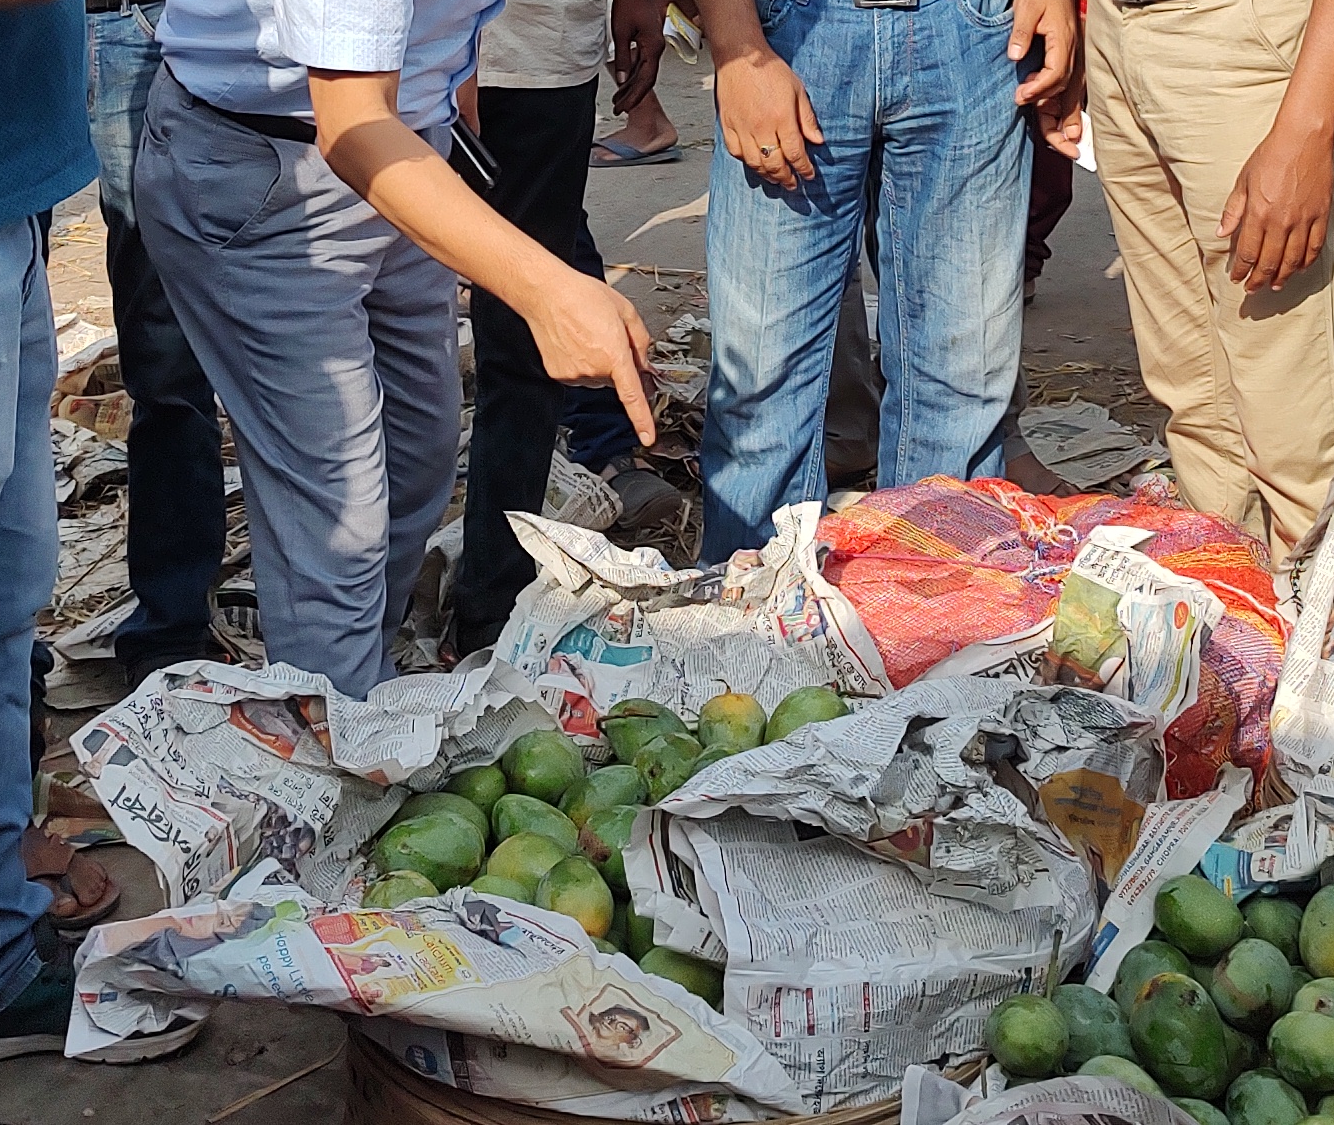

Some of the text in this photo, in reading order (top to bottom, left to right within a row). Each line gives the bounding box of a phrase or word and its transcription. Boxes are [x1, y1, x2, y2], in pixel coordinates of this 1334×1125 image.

[107, 783, 192, 855] পত্রিকা
[275, 930, 316, 1003] Happy Little
[414, 949, 446, 986] Lactate
[421, 933, 455, 975] Calcium
